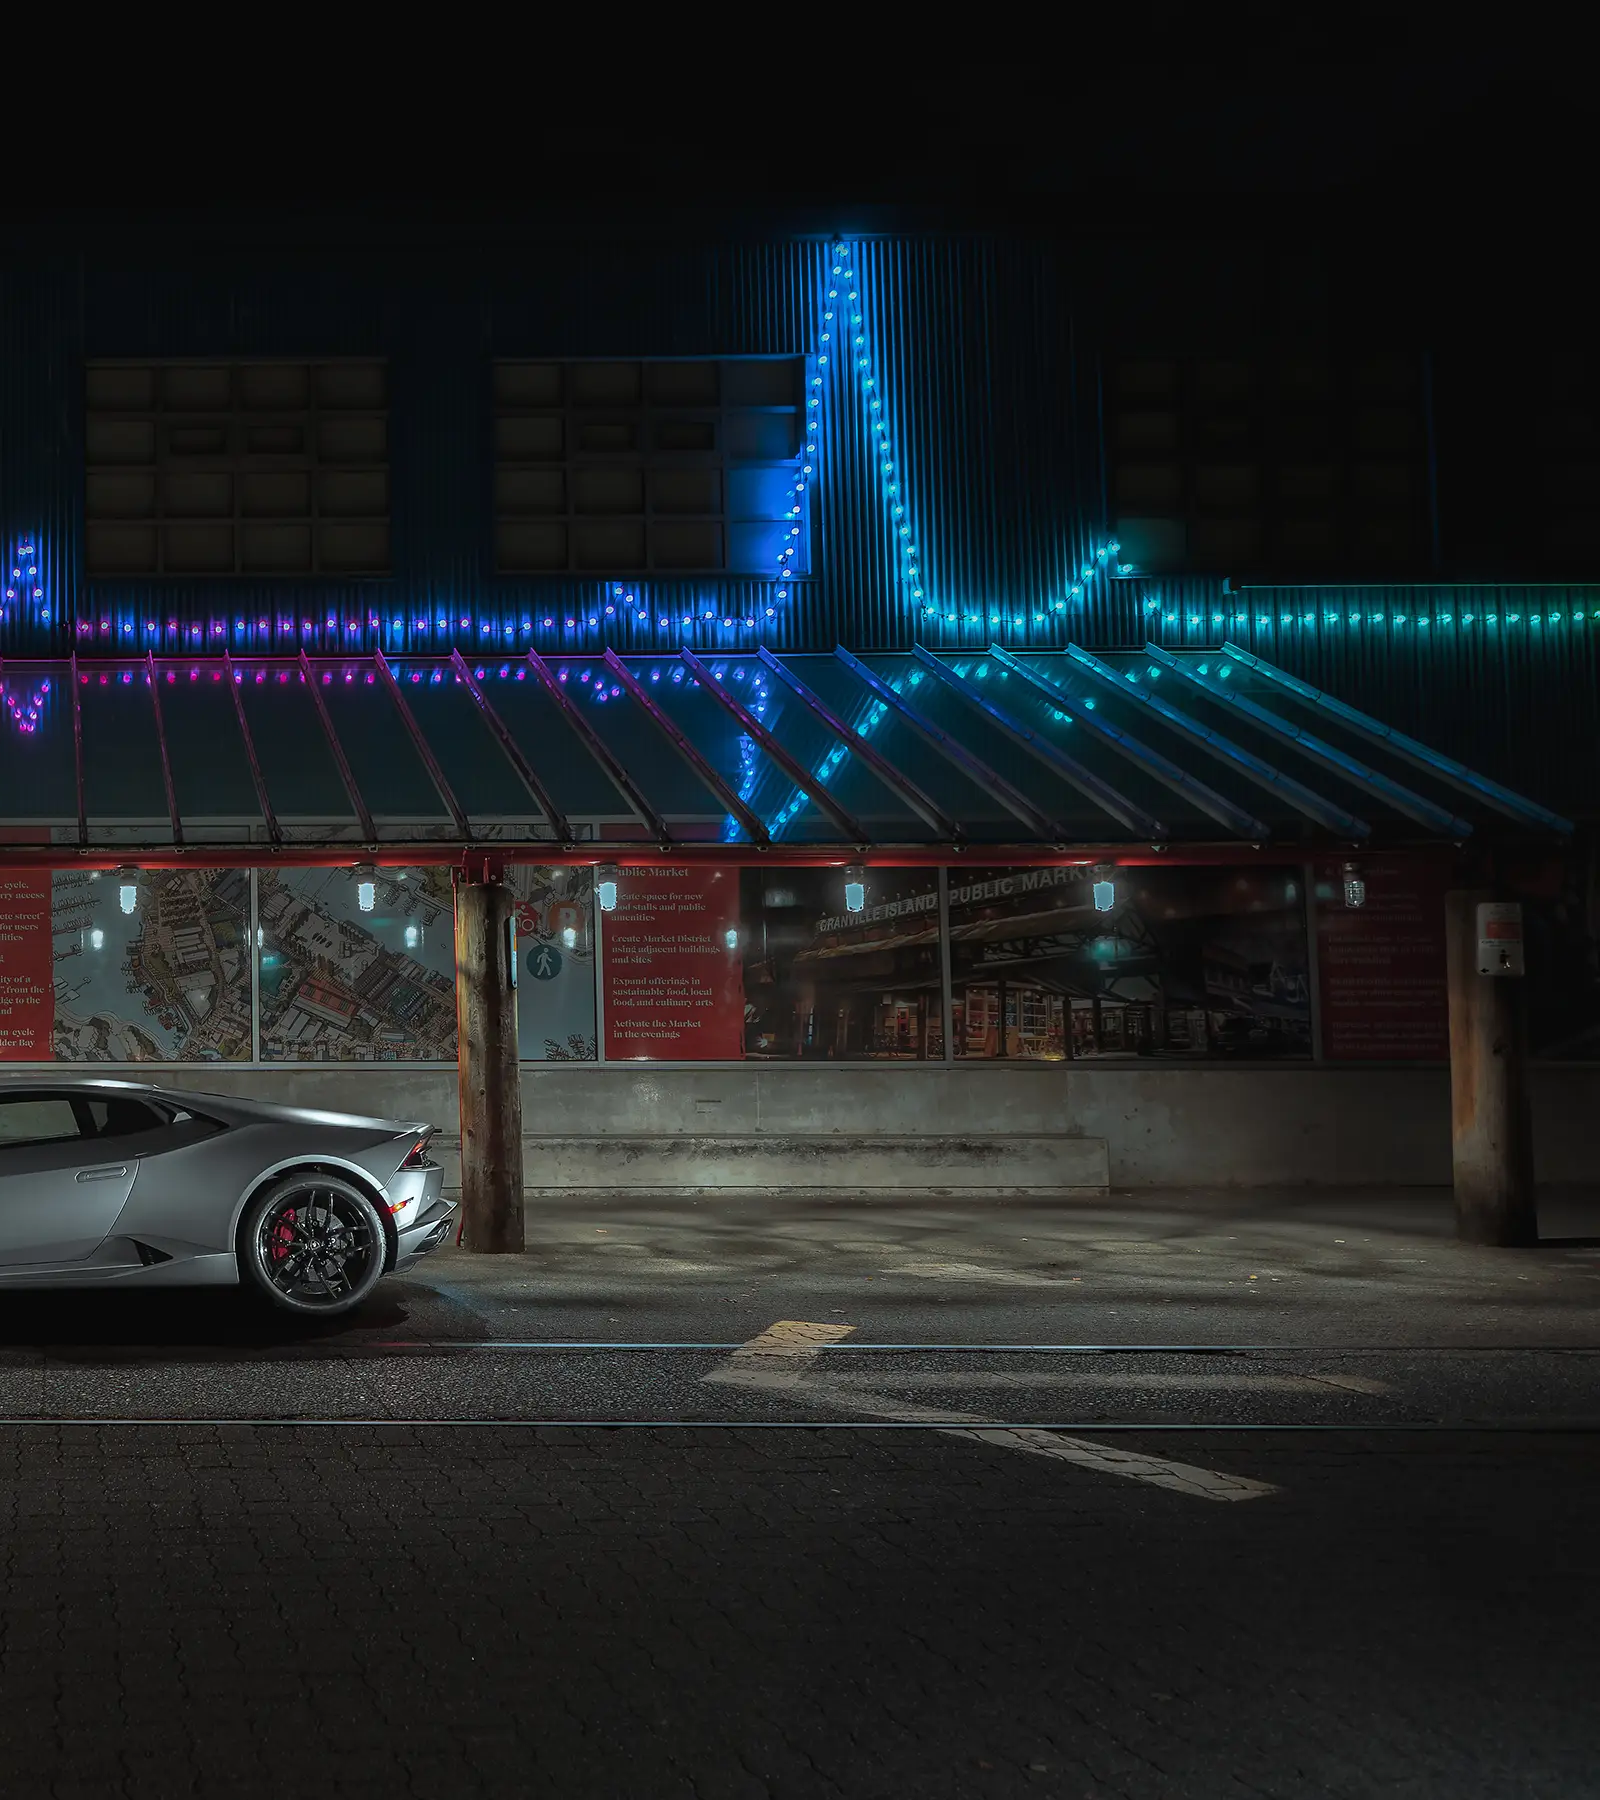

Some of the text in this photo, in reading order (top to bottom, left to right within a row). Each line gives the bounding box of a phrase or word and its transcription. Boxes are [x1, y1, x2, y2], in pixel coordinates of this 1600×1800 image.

[648, 867, 689, 877] Market
[642, 894, 667, 902] space
[819, 866, 1094, 931] GRANVILLE ISLAND PUBLIC MARK
[616, 903, 706, 914] ood stalls and public
[0, 923, 12, 931] for
[611, 935, 711, 943] Create Market District
[612, 945, 721, 954] using adjacent buildings
[612, 956, 653, 964] and sites
[613, 977, 700, 986] Expand offerings in
[613, 988, 713, 996] sustainable food, local
[26, 997, 41, 1005] the
[613, 998, 635, 1006] food,
[655, 999, 693, 1007] culinary
[613, 1020, 701, 1028] Activate the Market
[613, 1030, 681, 1039] in the evenings
[19, 1039, 36, 1048] Bay
